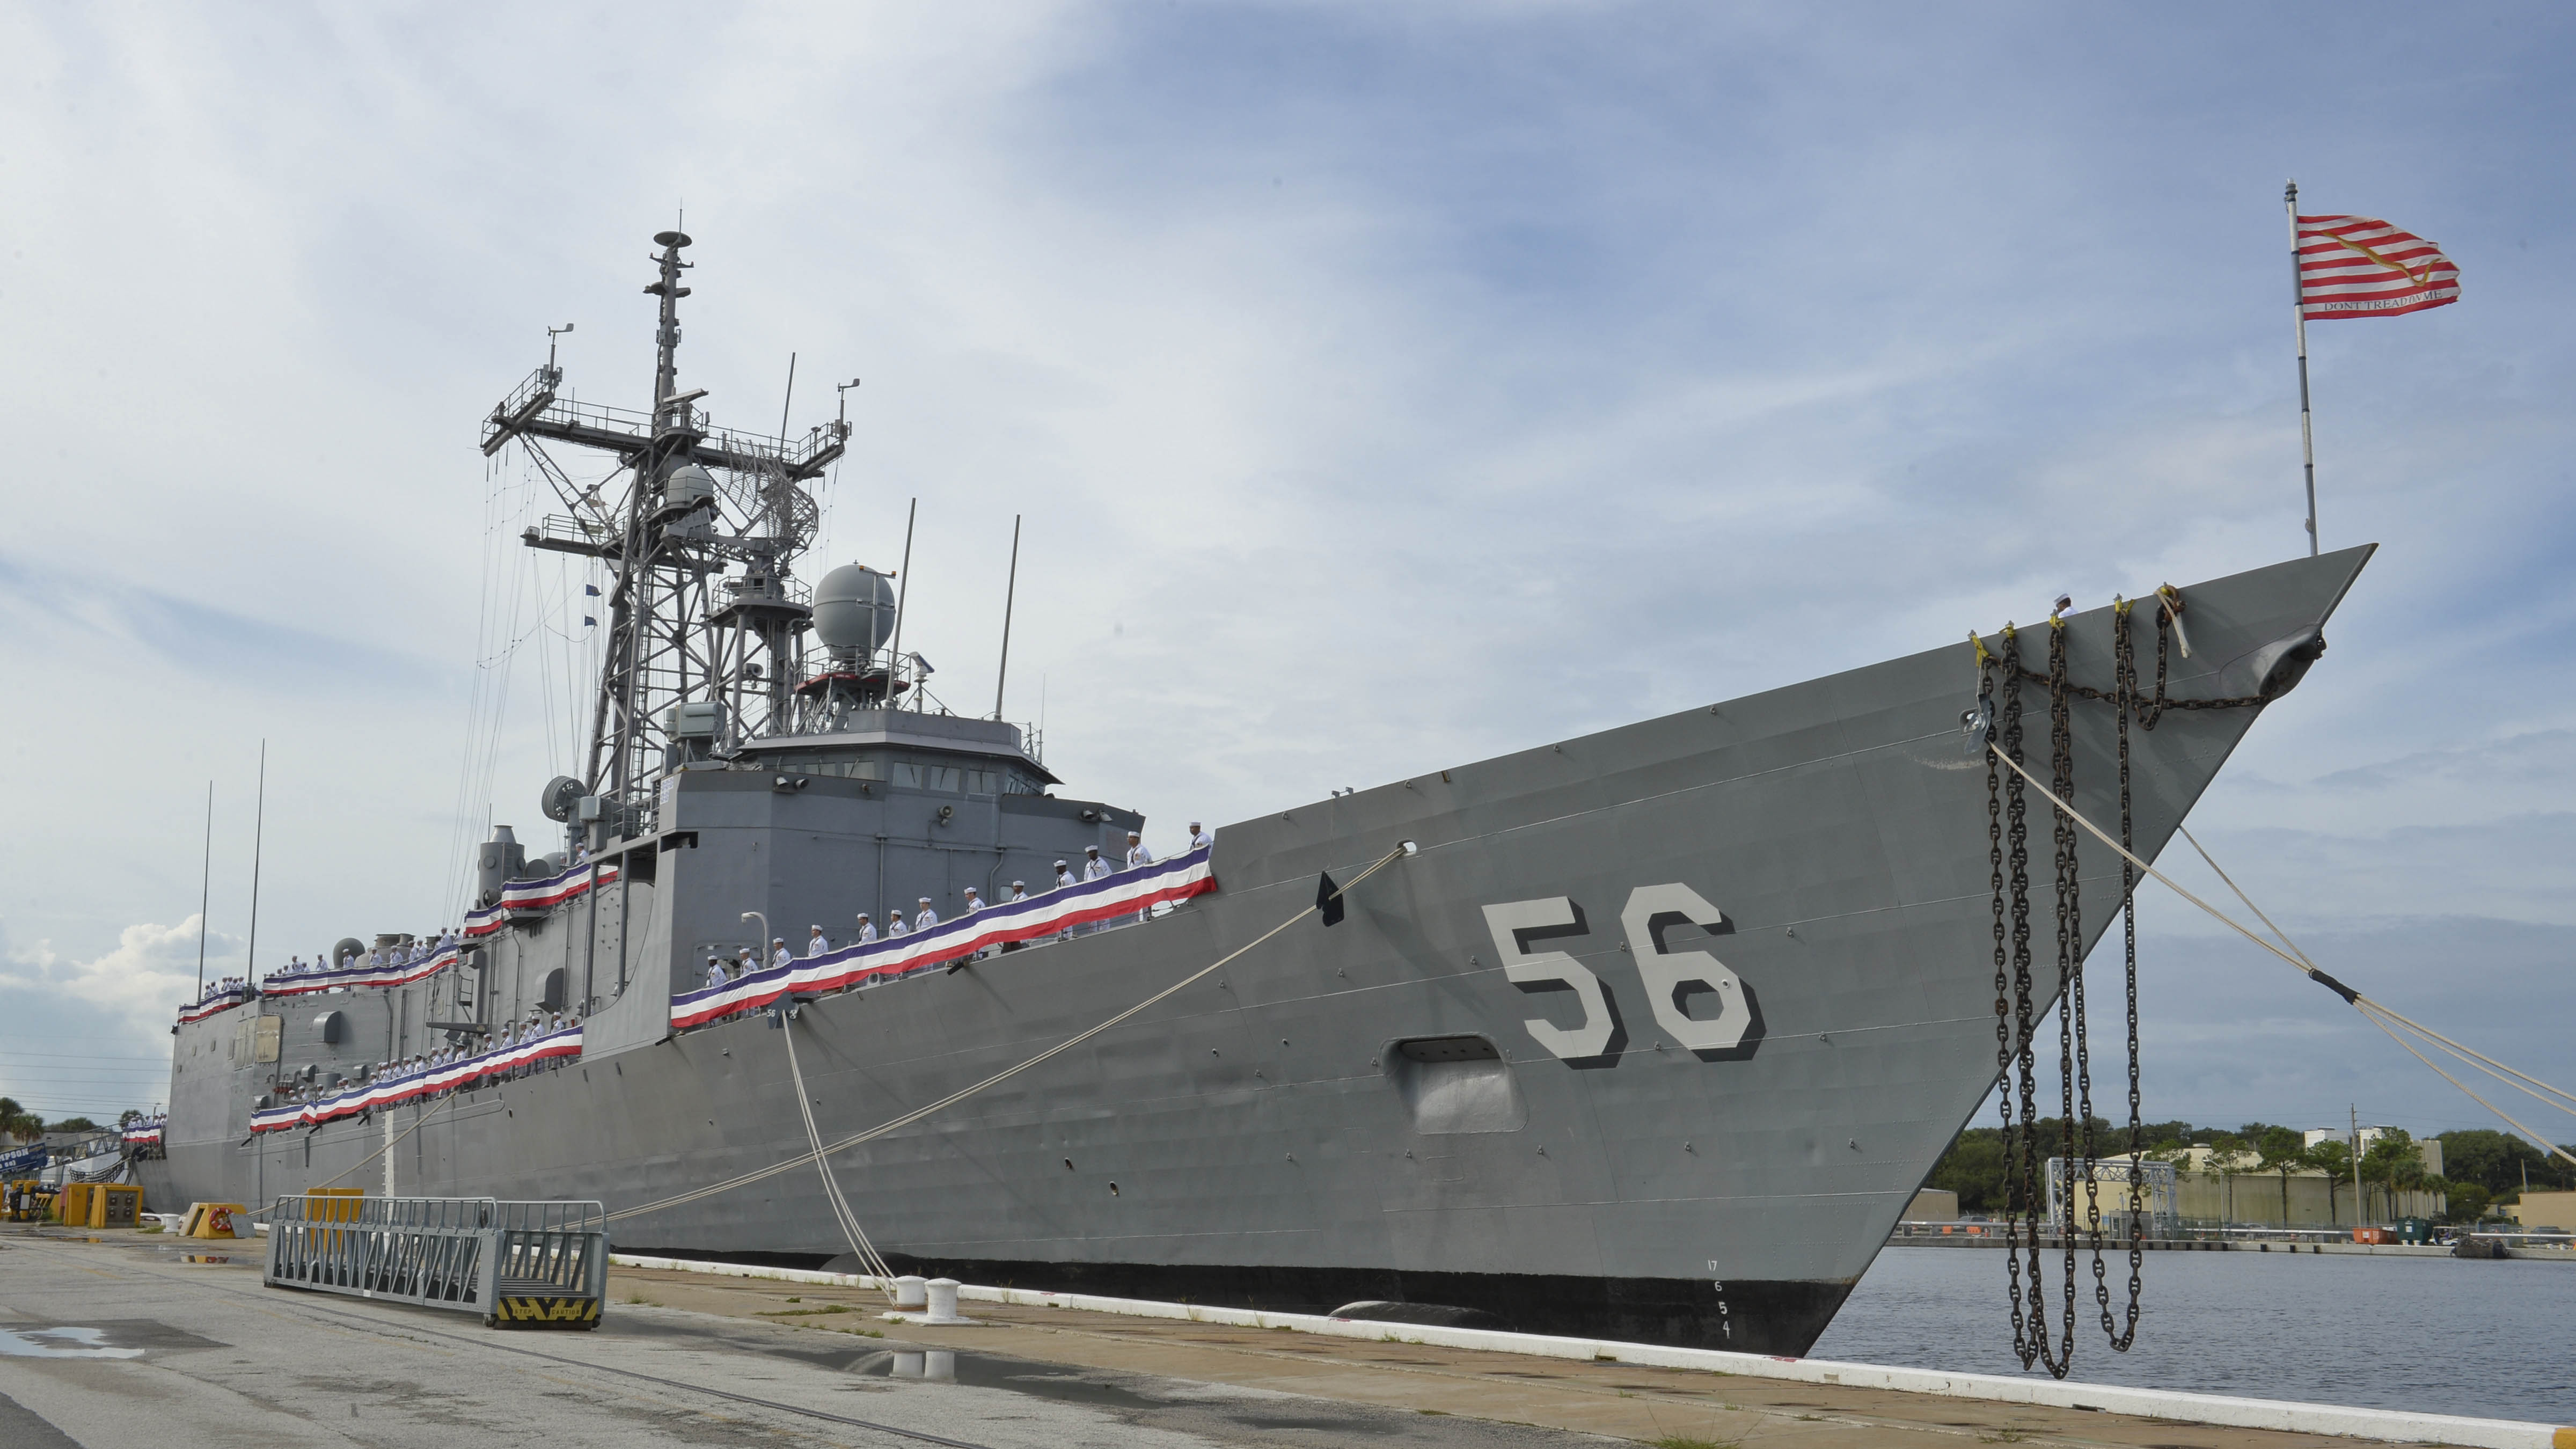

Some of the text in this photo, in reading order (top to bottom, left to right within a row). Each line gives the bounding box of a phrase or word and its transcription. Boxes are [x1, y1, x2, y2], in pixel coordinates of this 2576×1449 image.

[2324, 290, 2442, 311] DONT TREAD ON ME
[1481, 882, 1754, 1060] 56
[1708, 1260, 1717, 1271] 17
[1715, 1281, 1722, 1291] 6
[1718, 1301, 1728, 1314] 5
[1723, 1321, 1730, 1339] 4
